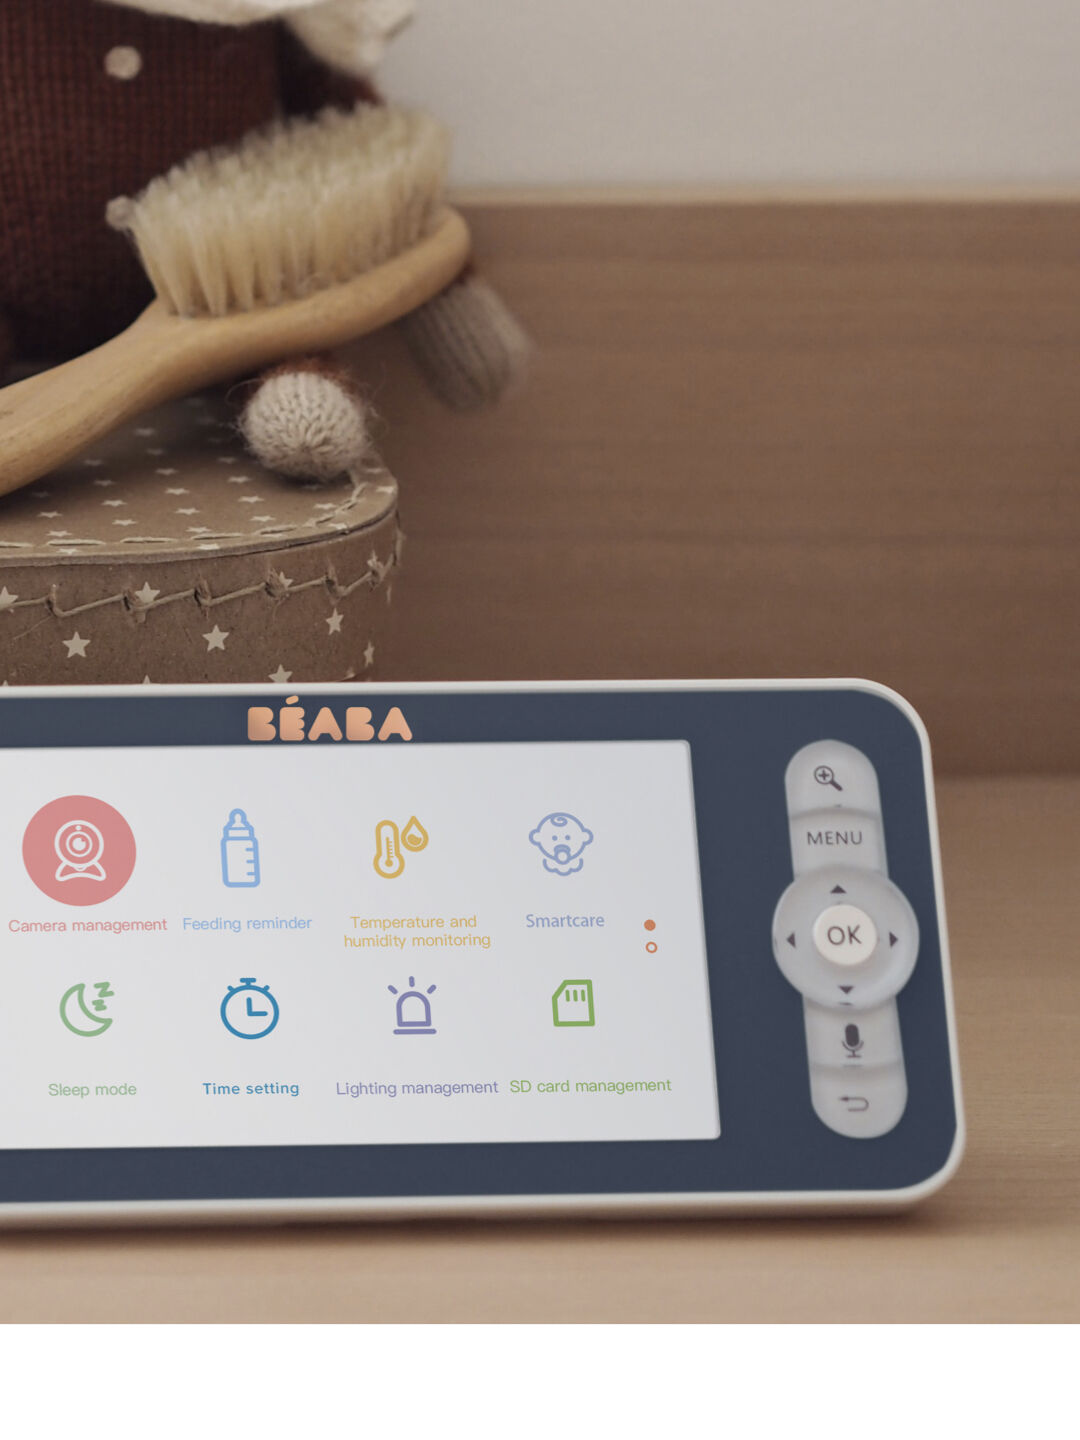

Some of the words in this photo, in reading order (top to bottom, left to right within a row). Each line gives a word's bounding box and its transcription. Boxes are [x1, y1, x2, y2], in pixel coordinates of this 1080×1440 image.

[247, 695, 413, 741] BÉABA
[806, 830, 863, 846] MENU
[8, 919, 67, 933] Camera
[72, 919, 168, 935] management
[182, 917, 242, 934] Feeding
[246, 916, 313, 930] reminder
[350, 915, 445, 931] Temperature
[449, 914, 478, 928] and
[525, 913, 605, 929] Smartcare
[343, 934, 407, 950] humidity
[412, 933, 492, 950] monitoring
[826, 924, 863, 947] OK
[47, 1082, 90, 1099] Sleep
[95, 1082, 137, 1097] mode
[202, 1082, 240, 1097] Time
[245, 1081, 300, 1098] setting
[336, 1081, 398, 1098] Lighting
[402, 1081, 500, 1098] management
[509, 1079, 533, 1094] SD
[536, 1079, 571, 1094] card
[575, 1079, 673, 1096] management
